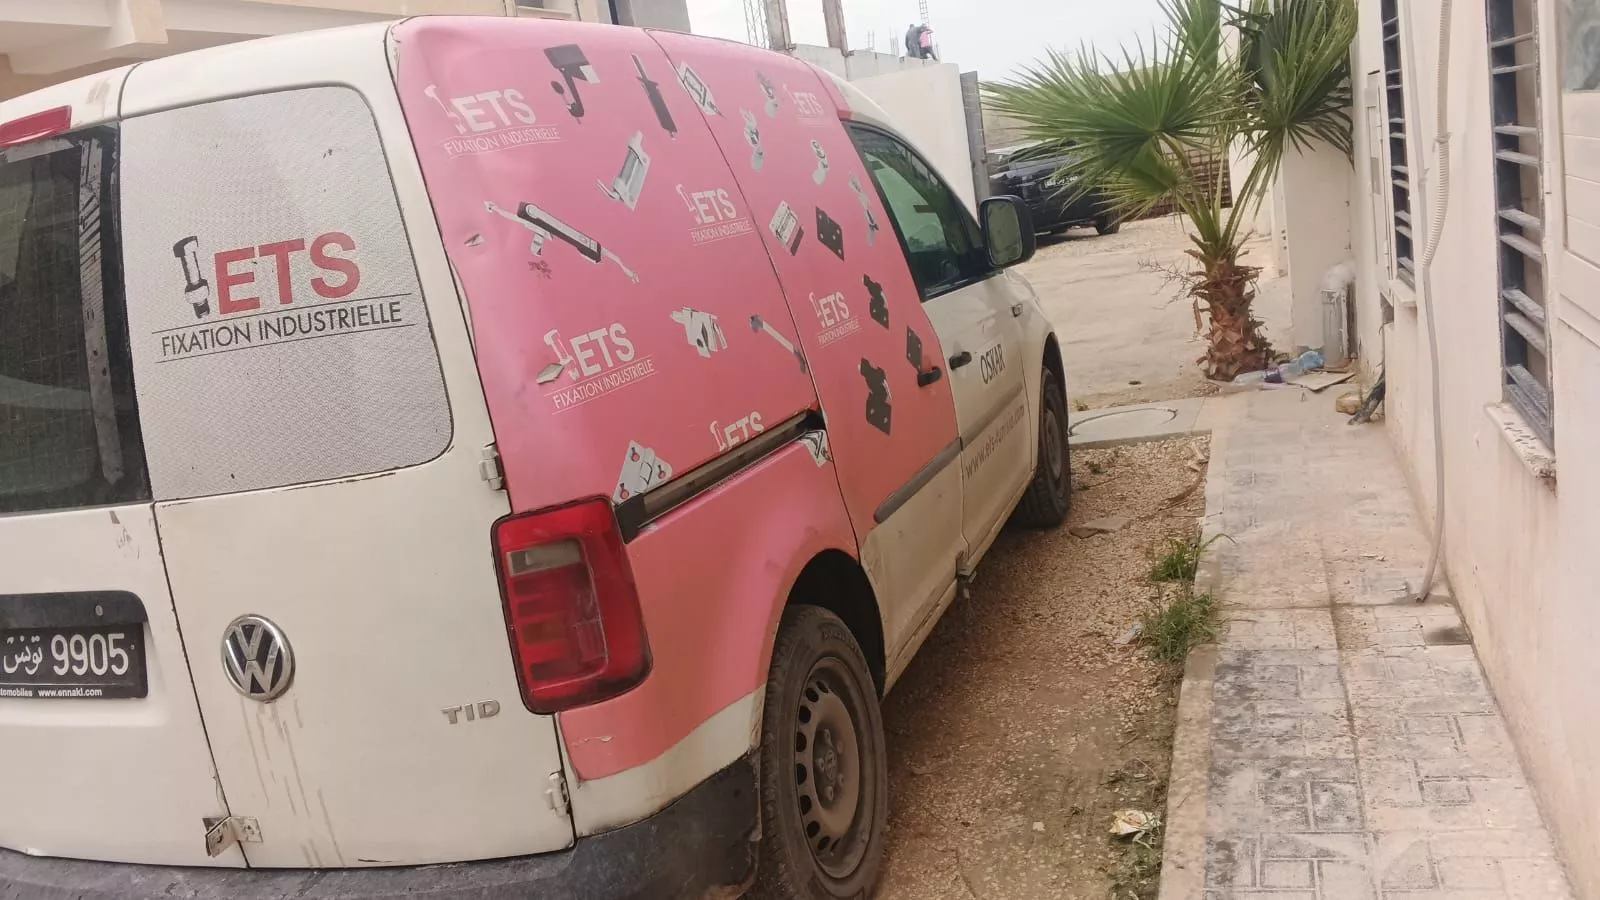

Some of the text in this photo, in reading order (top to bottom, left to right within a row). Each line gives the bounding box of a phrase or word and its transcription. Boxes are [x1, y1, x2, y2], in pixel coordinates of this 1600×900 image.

[451, 88, 536, 133] ETS
[443, 136, 501, 156] FIXATION
[692, 188, 737, 224] ETS
[214, 231, 361, 315] ETS
[161, 301, 402, 357] FIXATION INDUSTRIELLE
[820, 291, 850, 328] ETS
[569, 322, 635, 377] ETS
[980, 343, 1006, 385] OSKAR
[553, 359, 655, 409] FIXATION INDUSTRIELLE
[724, 410, 765, 449] ETS
[3, 633, 129, 676] تونس 9905
[38, 687, 103, 697] www.ennakl.com
